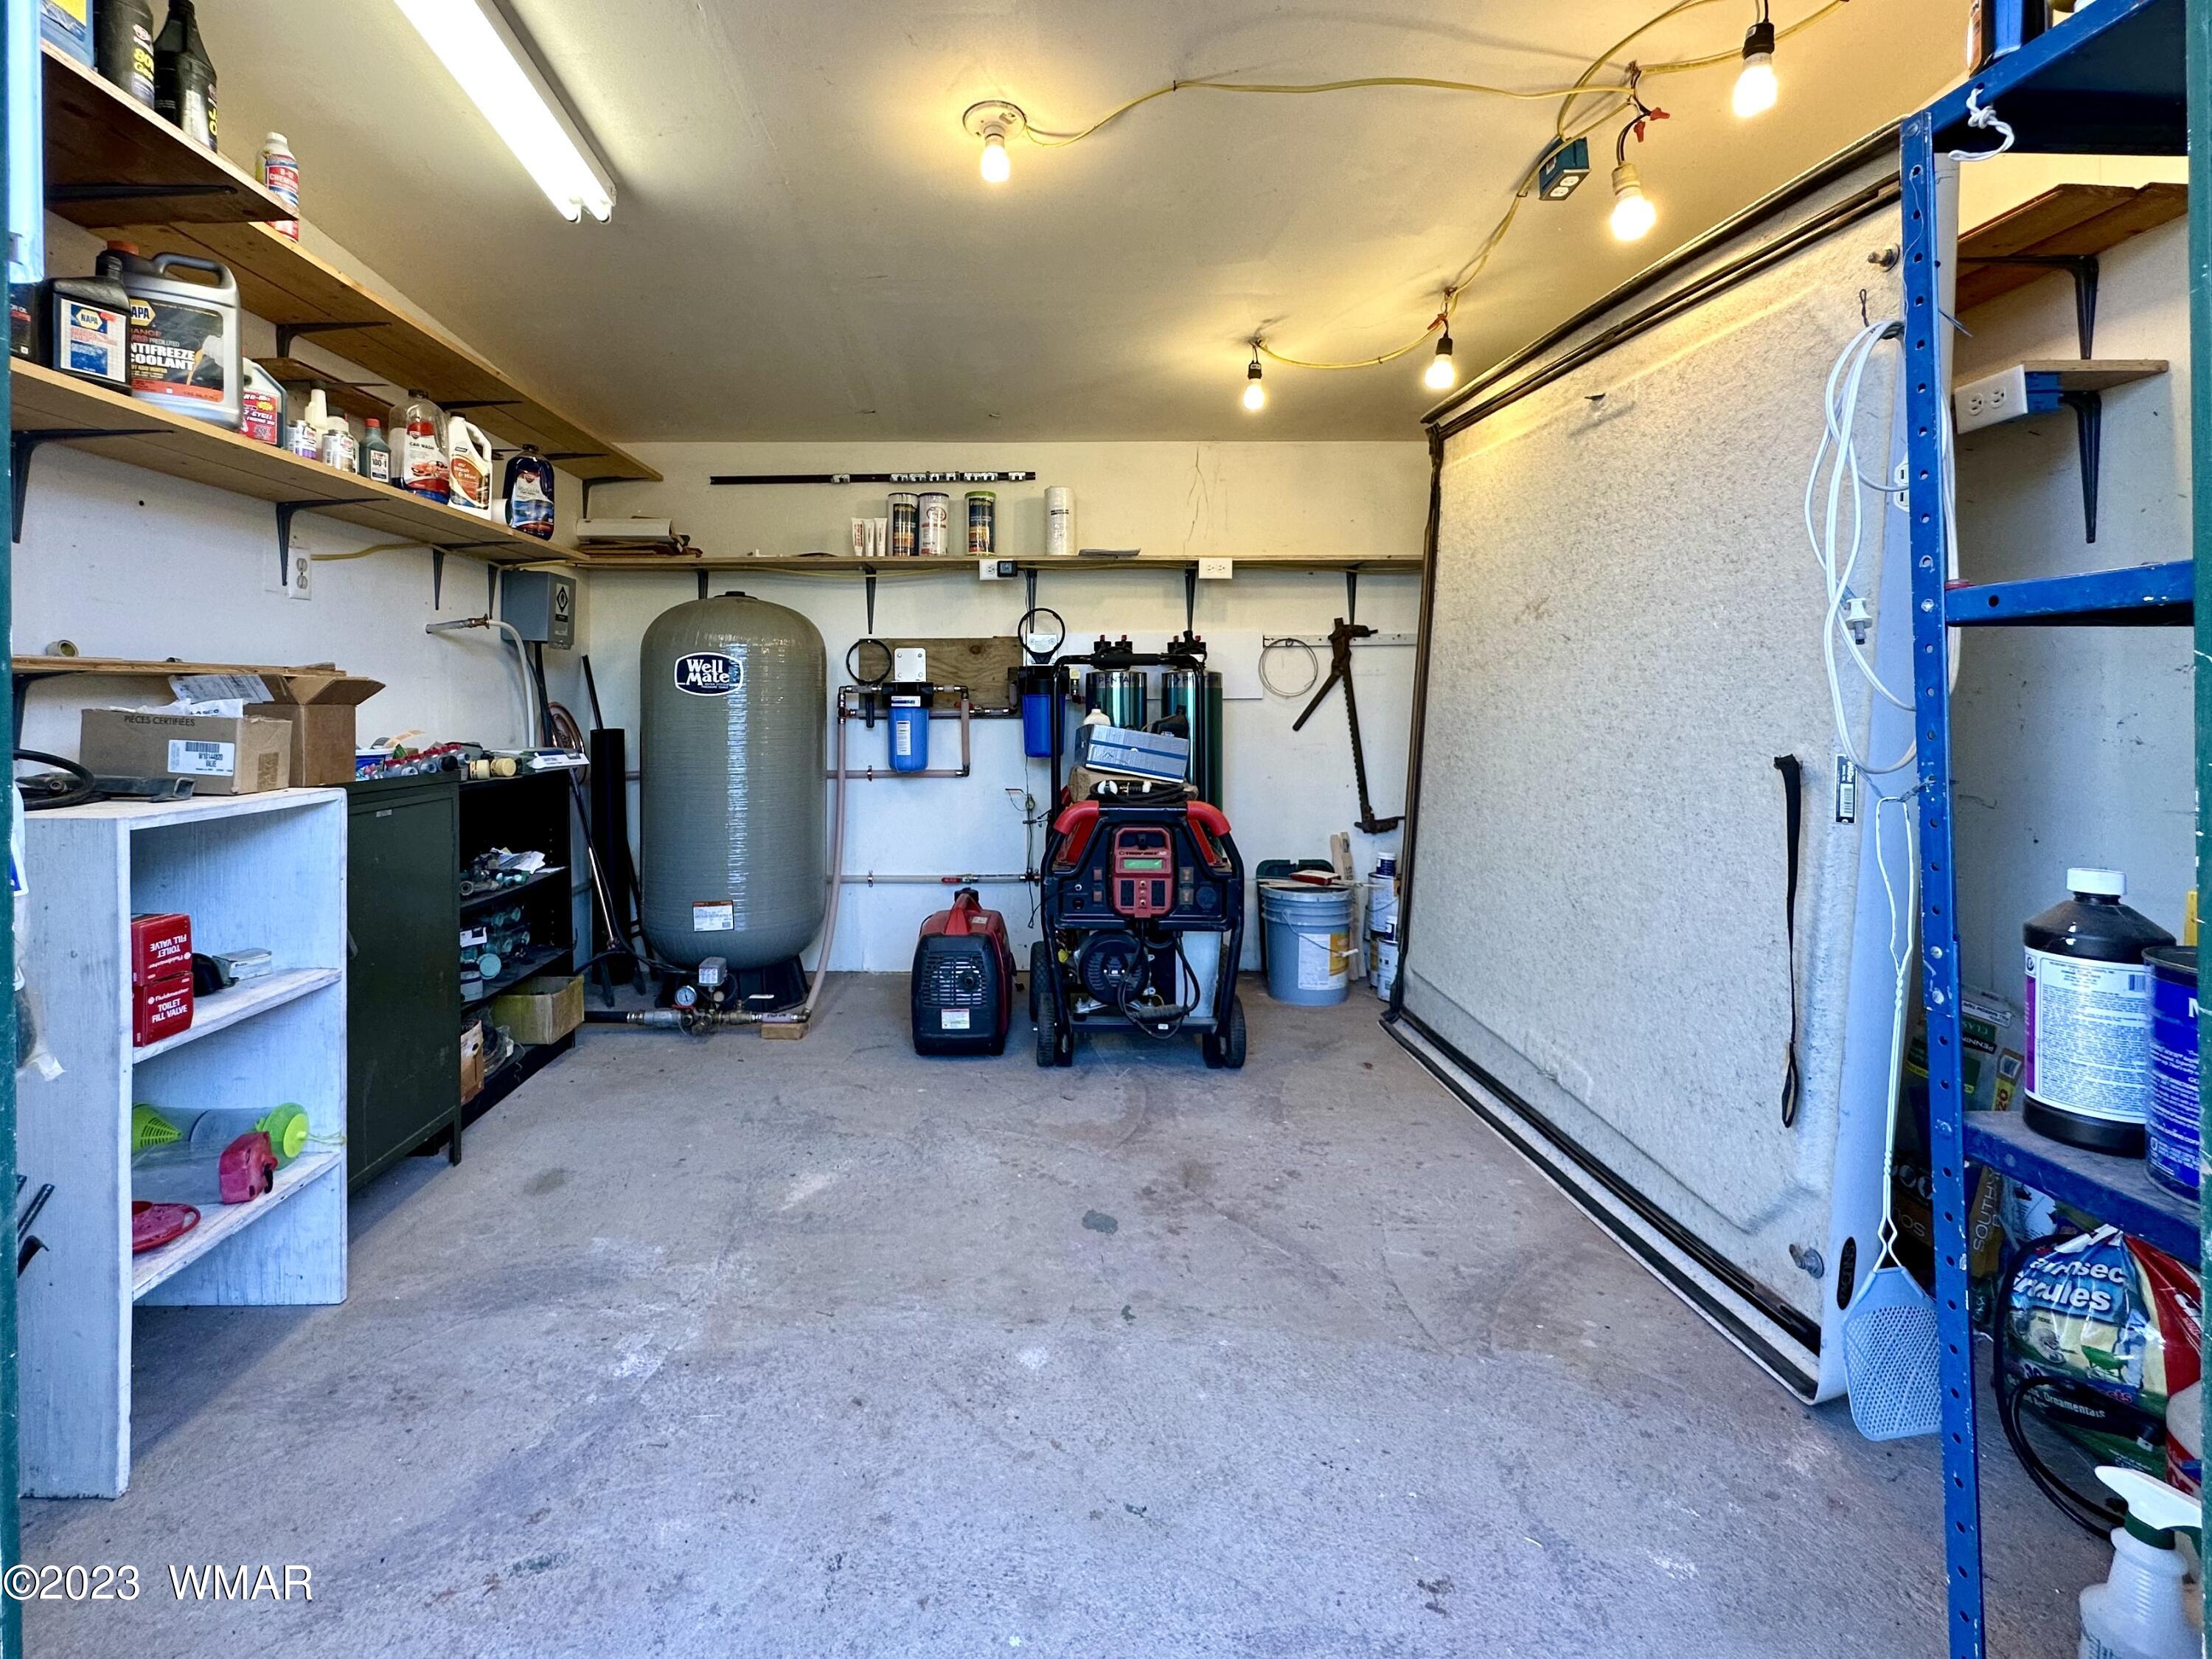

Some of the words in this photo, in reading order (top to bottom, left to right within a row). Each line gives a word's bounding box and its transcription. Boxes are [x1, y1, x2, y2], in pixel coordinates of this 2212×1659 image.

[80, 313, 99, 325] NAPA
[131, 306, 150, 319] APA
[131, 342, 195, 361] NTIFREEZE
[686, 658, 723, 673] Well
[686, 672, 730, 686] Mate
[150, 939, 173, 952] VALVE
[173, 934, 187, 944] FILL
[157, 945, 181, 959] TOILET
[158, 998, 181, 1012] TOILET
[152, 1012, 166, 1023] FILL
[167, 1004, 187, 1018] VALVE
[1962, 1020, 1989, 1035] CLAS
[1962, 1036, 1994, 1052] PENNIN
[2043, 1391, 2107, 1419] Ornamentals
